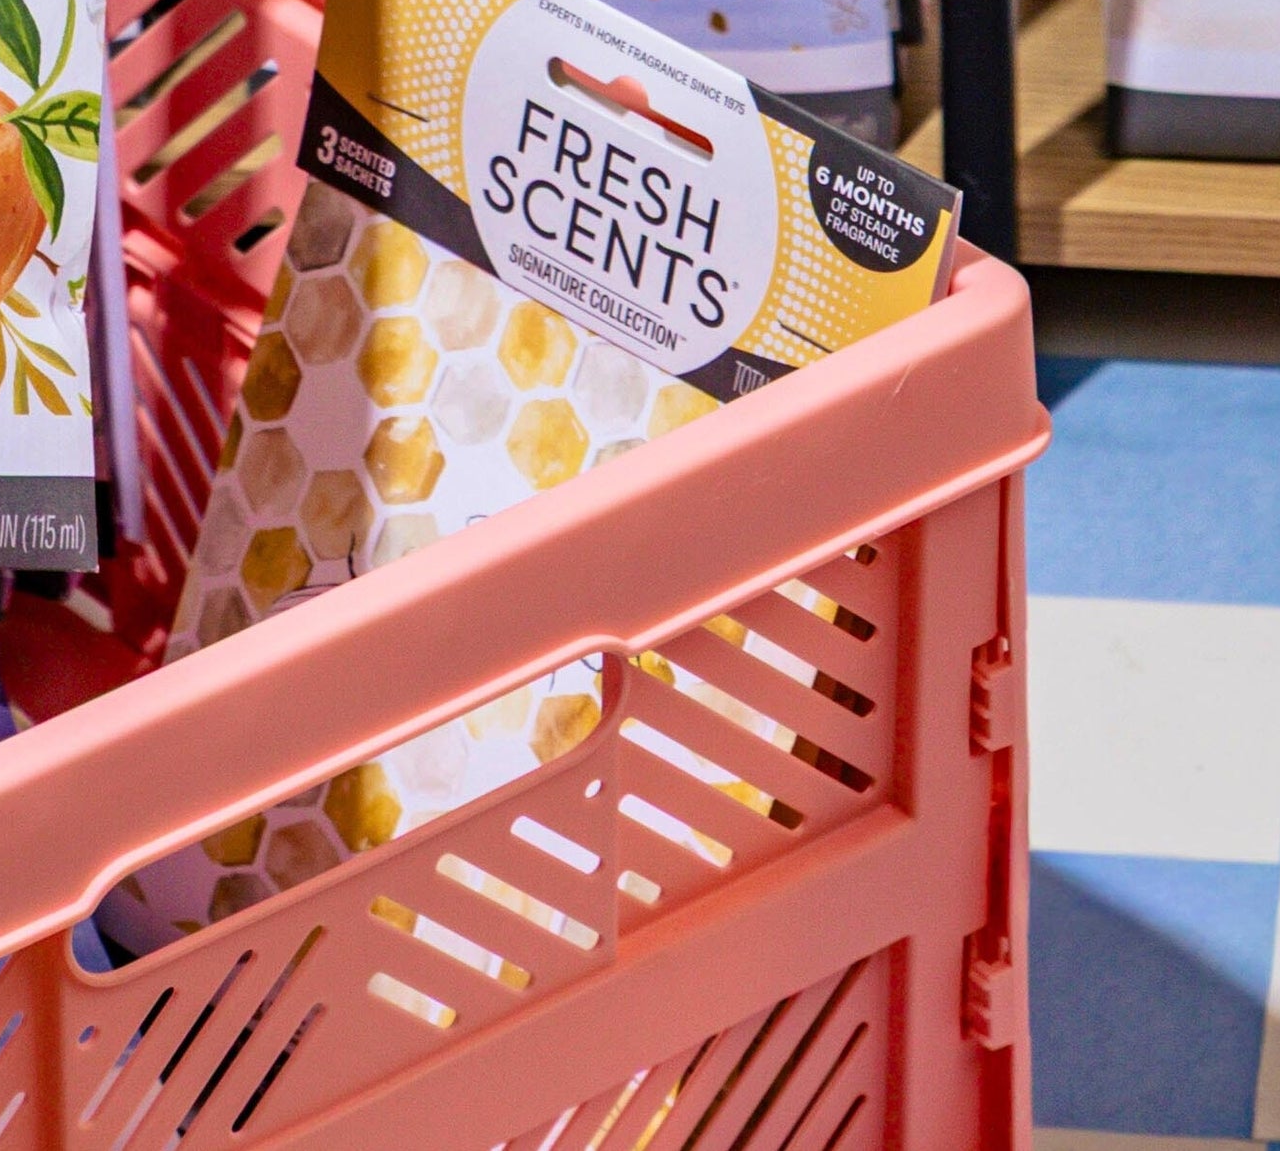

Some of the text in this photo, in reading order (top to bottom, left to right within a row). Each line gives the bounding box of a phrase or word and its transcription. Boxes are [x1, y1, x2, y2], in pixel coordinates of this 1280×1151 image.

[583, 17, 595, 36] IN
[596, 22, 628, 54] HOME
[628, 38, 689, 86] FRAGRANCE
[689, 75, 723, 105] SINCE
[724, 93, 746, 116] 1975
[317, 125, 338, 165] 3
[339, 136, 396, 178] SCENTED
[334, 154, 393, 198] SACHETS
[517, 98, 721, 255] FRESH
[856, 165, 895, 196] UP TO
[815, 165, 925, 237] 6 MONTHS
[830, 197, 899, 243] OF STEADY
[482, 154, 730, 329] SCENTS
[824, 212, 901, 265] FRAGRANCE
[508, 244, 681, 353] SIGNATURE COLLECTION
[0, 513, 17, 550] IN
[20, 514, 56, 553] (115
[58, 515, 86, 555] ml)
